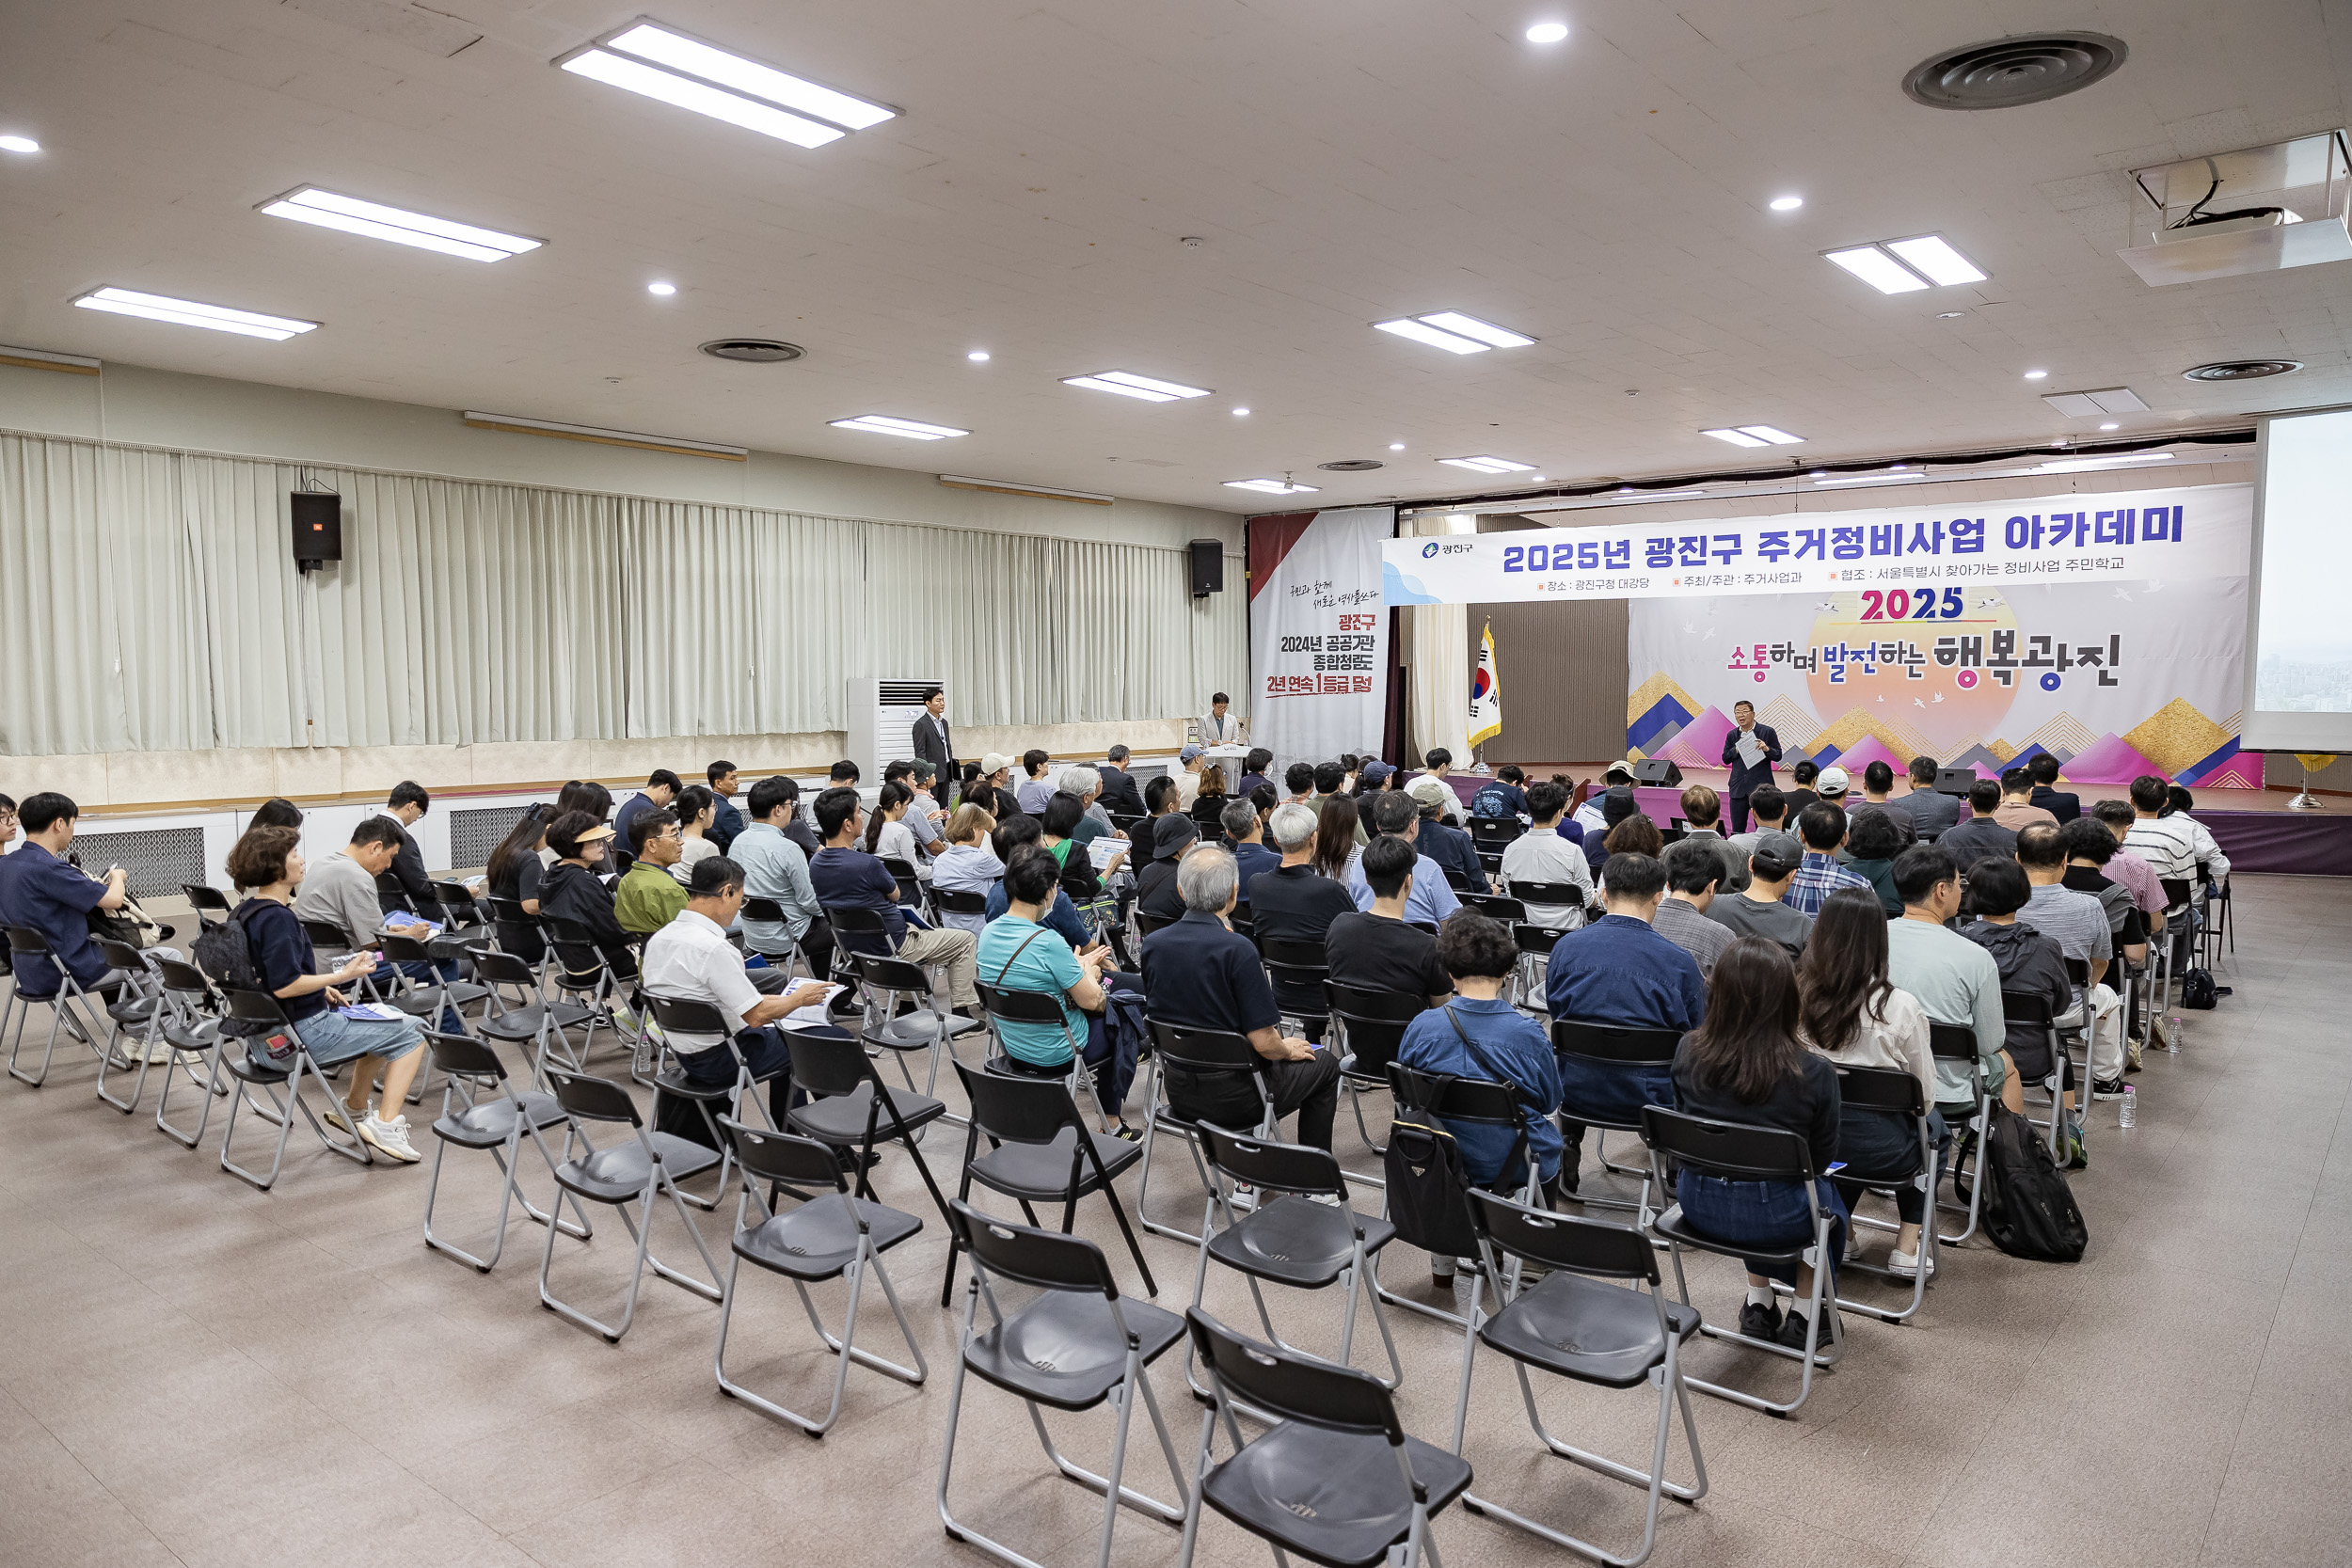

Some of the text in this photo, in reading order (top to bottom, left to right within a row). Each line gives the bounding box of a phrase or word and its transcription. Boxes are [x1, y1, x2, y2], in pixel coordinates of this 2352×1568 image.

[1503, 505, 2183, 573] 2025년 광진구 주거정비사업 아카데미
[1442, 544, 1473, 555] 광진구
[1841, 569, 1866, 581] 협조
[1877, 565, 1941, 579] 서울특별시
[1946, 562, 1999, 578] 찾아가는
[2004, 560, 2060, 575] 정비사업
[2065, 557, 2124, 572] 주민학교
[1548, 580, 1566, 592] 장소
[1575, 579, 1616, 591] 광진구청
[1618, 578, 1650, 589] 대강당
[1684, 575, 1734, 587] 주최/주관
[1744, 572, 1802, 585] 주거사업과
[1312, 594, 1337, 610] 새로운
[1859, 587, 1963, 621] 2025
[1339, 613, 1375, 631] 광진구
[1280, 635, 1322, 653] 2024년
[1727, 629, 2121, 692] 소통하며 발전하는 행복광진
[1267, 675, 1286, 692] 2년
[1288, 675, 1313, 692] 연속
[1315, 673, 1349, 693] 1등급
